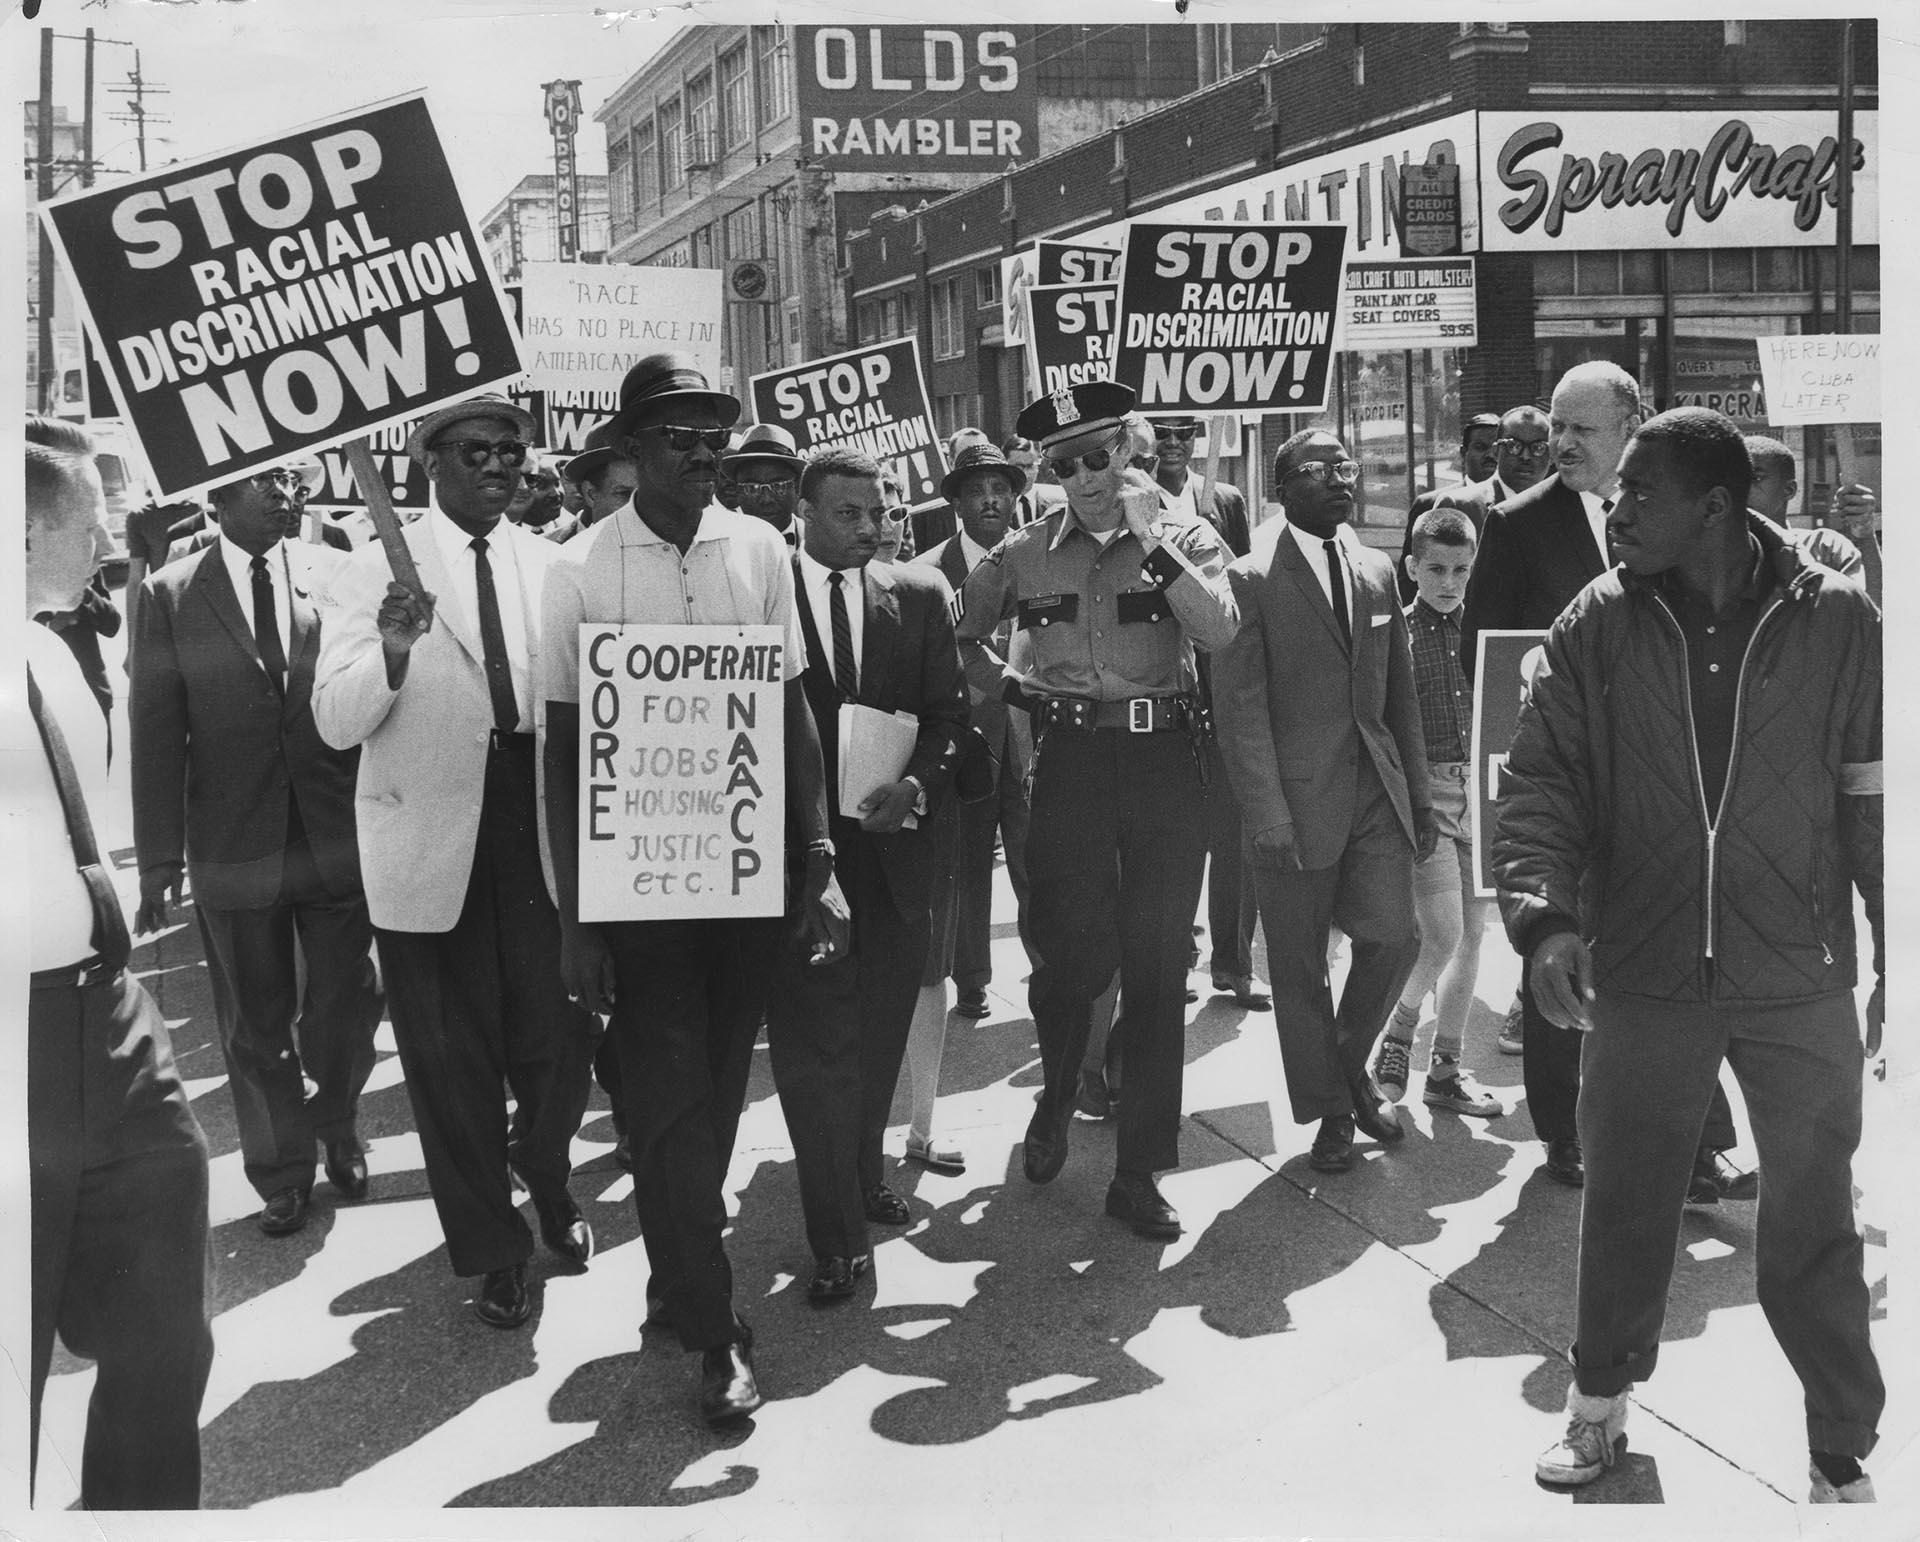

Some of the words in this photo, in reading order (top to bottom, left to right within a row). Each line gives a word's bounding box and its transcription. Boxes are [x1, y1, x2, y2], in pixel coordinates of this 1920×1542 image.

[815, 28, 1018, 91] OLDS
[813, 117, 1022, 156] RAMBLER
[111, 129, 383, 269] STOP
[1407, 198, 1455, 210] CREDIT
[1406, 211, 1455, 222] CARDS
[191, 211, 390, 306] RACIAL
[1155, 231, 1312, 279] STOP
[1394, 270, 1416, 288] AUTO
[118, 231, 476, 393] DISCRIMINATION
[1182, 283, 1292, 311] RACIAL
[1354, 294, 1387, 307] PAINT
[1391, 294, 1412, 307] ANY
[1415, 293, 1437, 305] CAR
[528, 317, 563, 337] HAS
[579, 319, 607, 338] NO
[619, 318, 681, 341] PLACE
[689, 322, 715, 342] IN
[1126, 311, 1329, 348] DISCRIMINATION
[1352, 311, 1383, 324] SEAT
[1393, 309, 1440, 322] COVERS
[1770, 341, 1828, 360] HERE
[1833, 340, 1880, 360] NOW
[179, 296, 480, 466] NOW!
[775, 354, 891, 420] STOP
[1141, 350, 1312, 404] NOW!
[1801, 371, 1854, 387] CUBA
[807, 400, 893, 443] RACIAL
[643, 695, 710, 724] FOR
[629, 747, 720, 778] JOBS
[625, 790, 725, 817] HOUSING
[725, 692, 763, 896] NAACP
[633, 871, 713, 895] etc.
